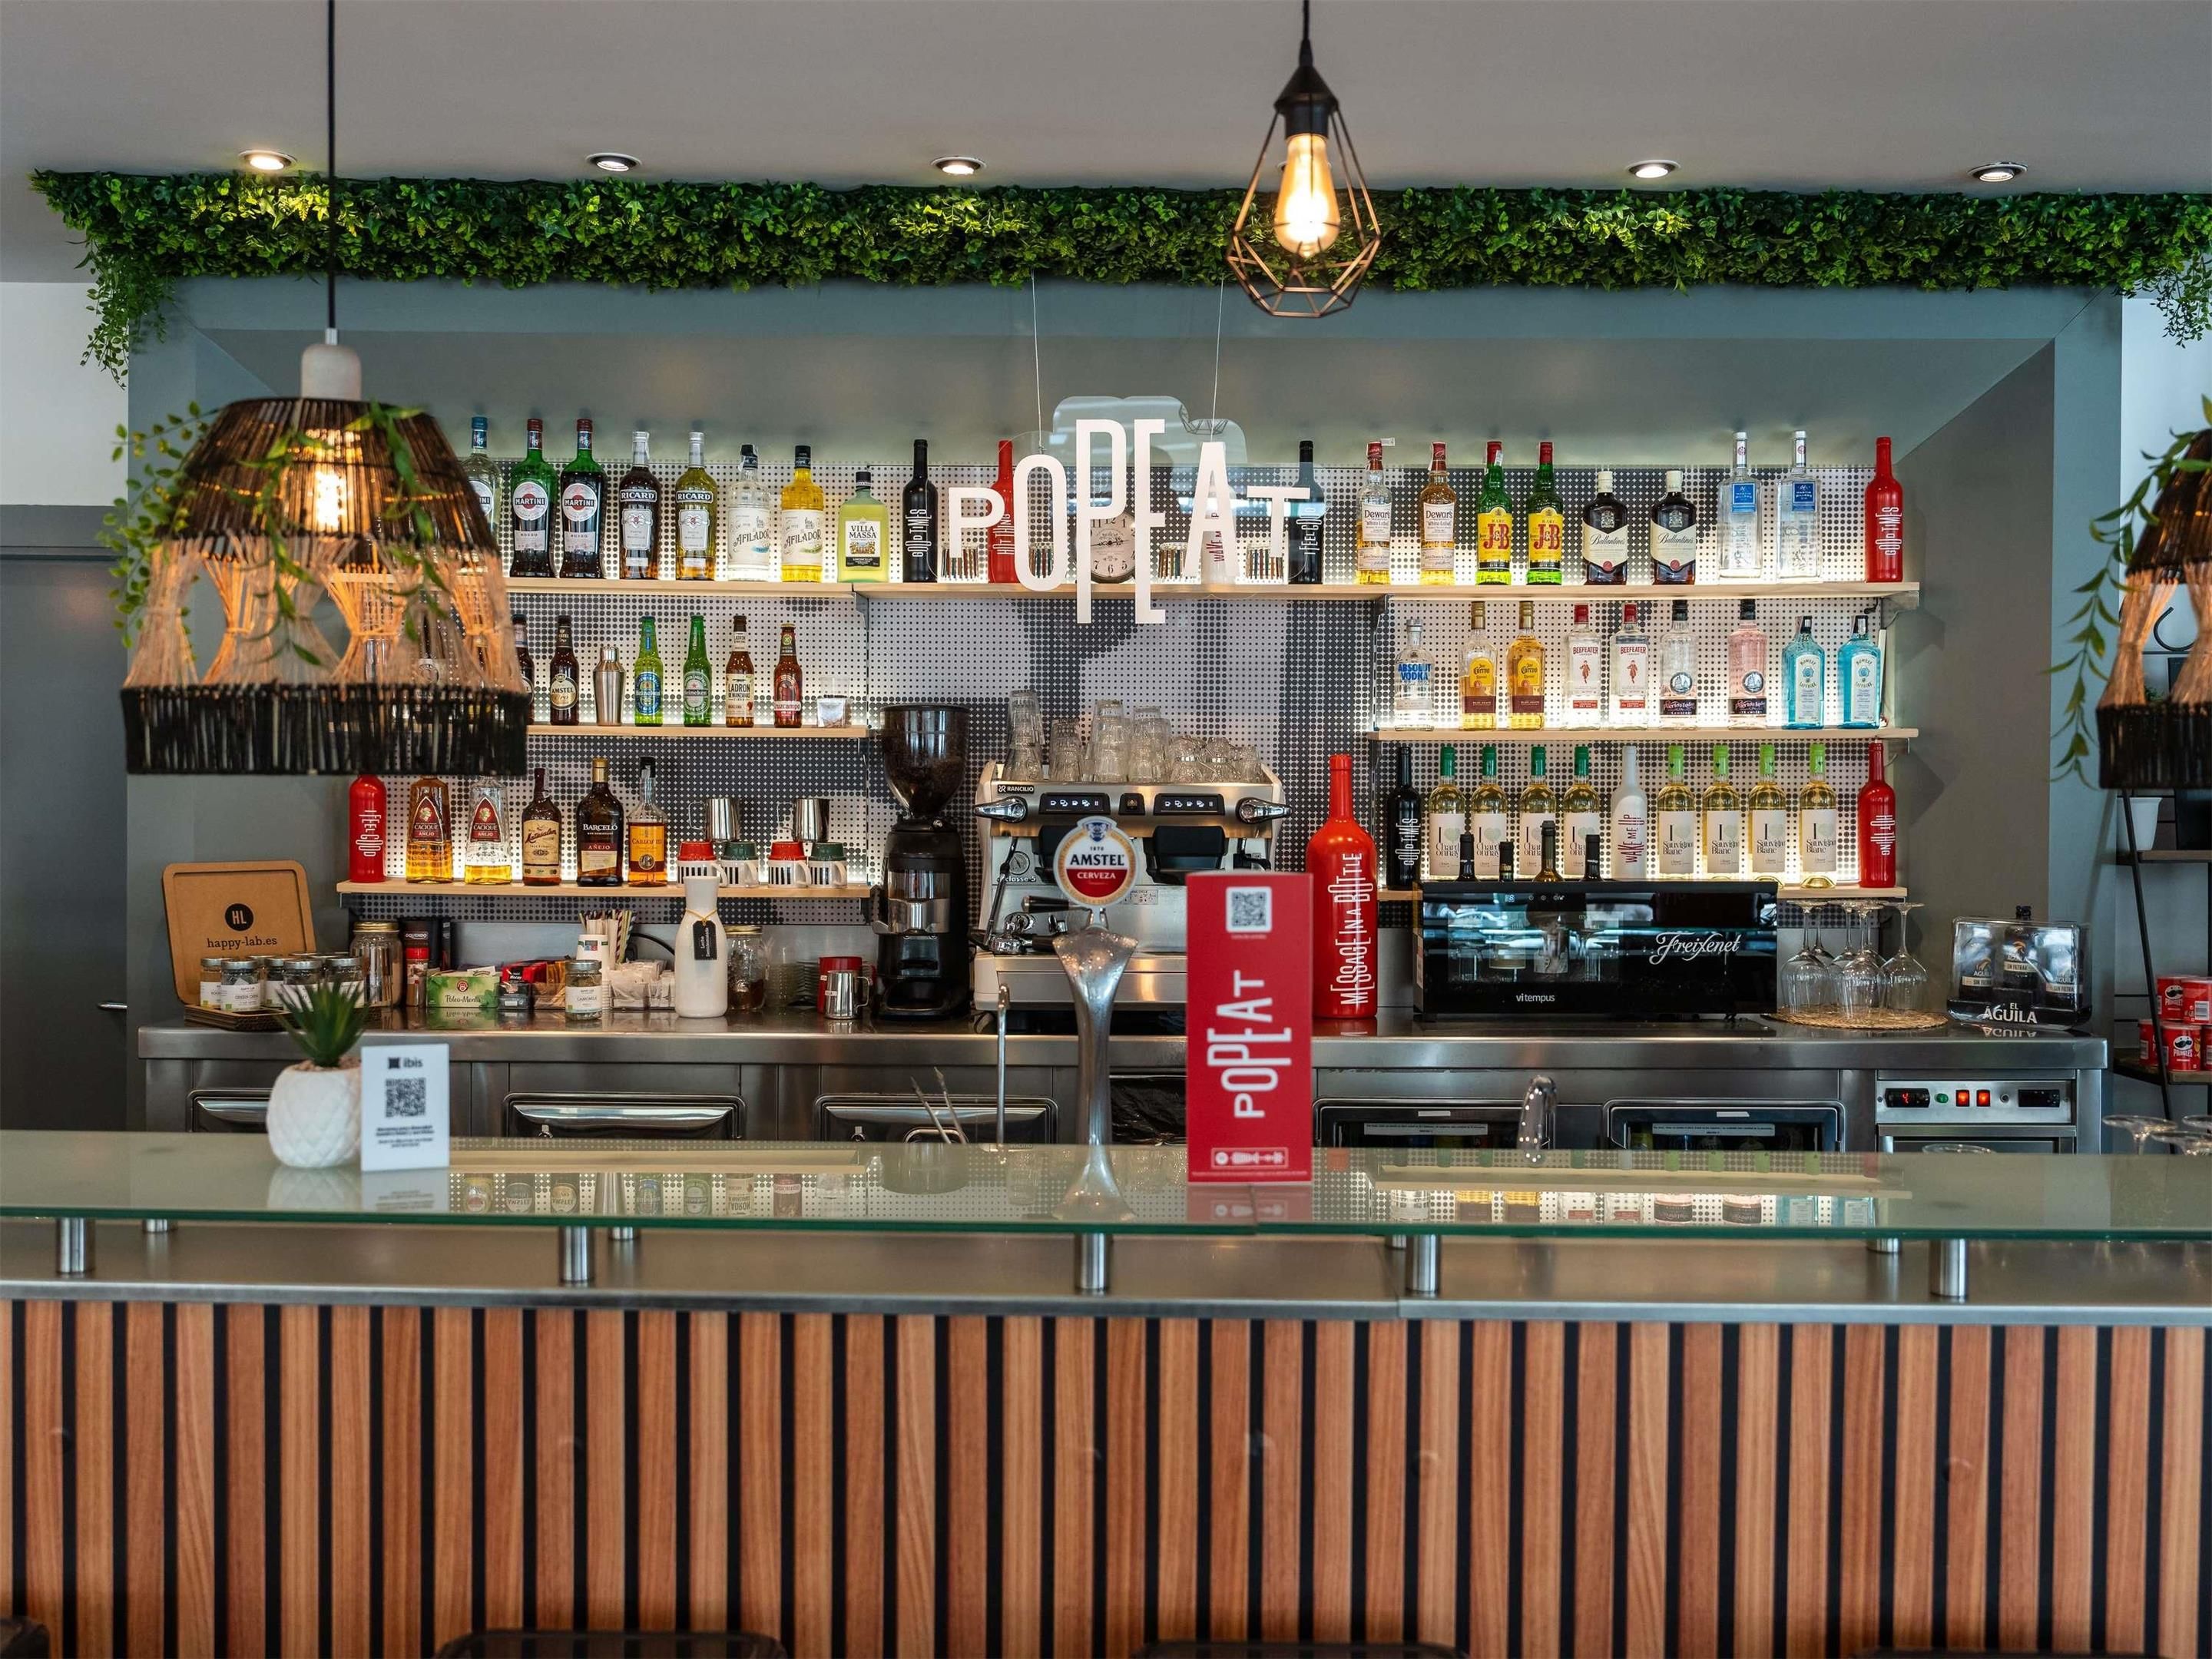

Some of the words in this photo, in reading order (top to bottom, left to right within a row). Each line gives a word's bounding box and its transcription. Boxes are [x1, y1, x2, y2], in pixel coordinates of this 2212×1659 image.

[515, 497, 545, 506] MARTINI
[565, 498, 594, 507] MARTINI
[621, 492, 654, 500] RICARD
[906, 508, 932, 536] TIMES
[949, 419, 1310, 624] POPEAT
[1426, 510, 1452, 518] Dewar's
[1875, 507, 1902, 531] TIMES
[784, 528, 822, 548] AFILADOR
[1299, 531, 1320, 551] FEEL
[1483, 524, 1510, 549] J&B
[1534, 524, 1561, 550] J&B
[1875, 533, 1902, 556] GOOD
[905, 536, 932, 558] GOOD
[1620, 646, 1646, 654] BEEFEATER
[1398, 663, 1432, 672] ABSOLUT
[1401, 672, 1429, 680] VODKA
[359, 813, 382, 833] FEEL
[1618, 814, 1644, 826] UP
[1870, 815, 1896, 830] HOT
[1396, 818, 1420, 841] TIMES
[1439, 826, 1442, 843] I
[1628, 827, 1637, 839] ME
[1670, 825, 1673, 841] I
[1719, 824, 1722, 840] I
[1764, 823, 1767, 839] I
[1813, 823, 1816, 839] I
[356, 834, 383, 856] GOOD
[1618, 841, 1644, 863] WAKE
[1870, 831, 1896, 856] THING
[1070, 853, 1124, 866] AMSTEL
[1395, 845, 1421, 866] GOOD
[1327, 853, 1373, 902] BOTTLE
[232, 910, 247, 924] HL
[1339, 919, 1367, 934] IN
[207, 935, 277, 950] happy-lab.es
[1649, 932, 1741, 965] Freixenet
[1330, 937, 1375, 1005] MESSAGE
[1983, 1006, 2038, 1024] ÁGUILA
[1207, 969, 1293, 1118] POPEAT
[403, 1057, 422, 1068] ibis
